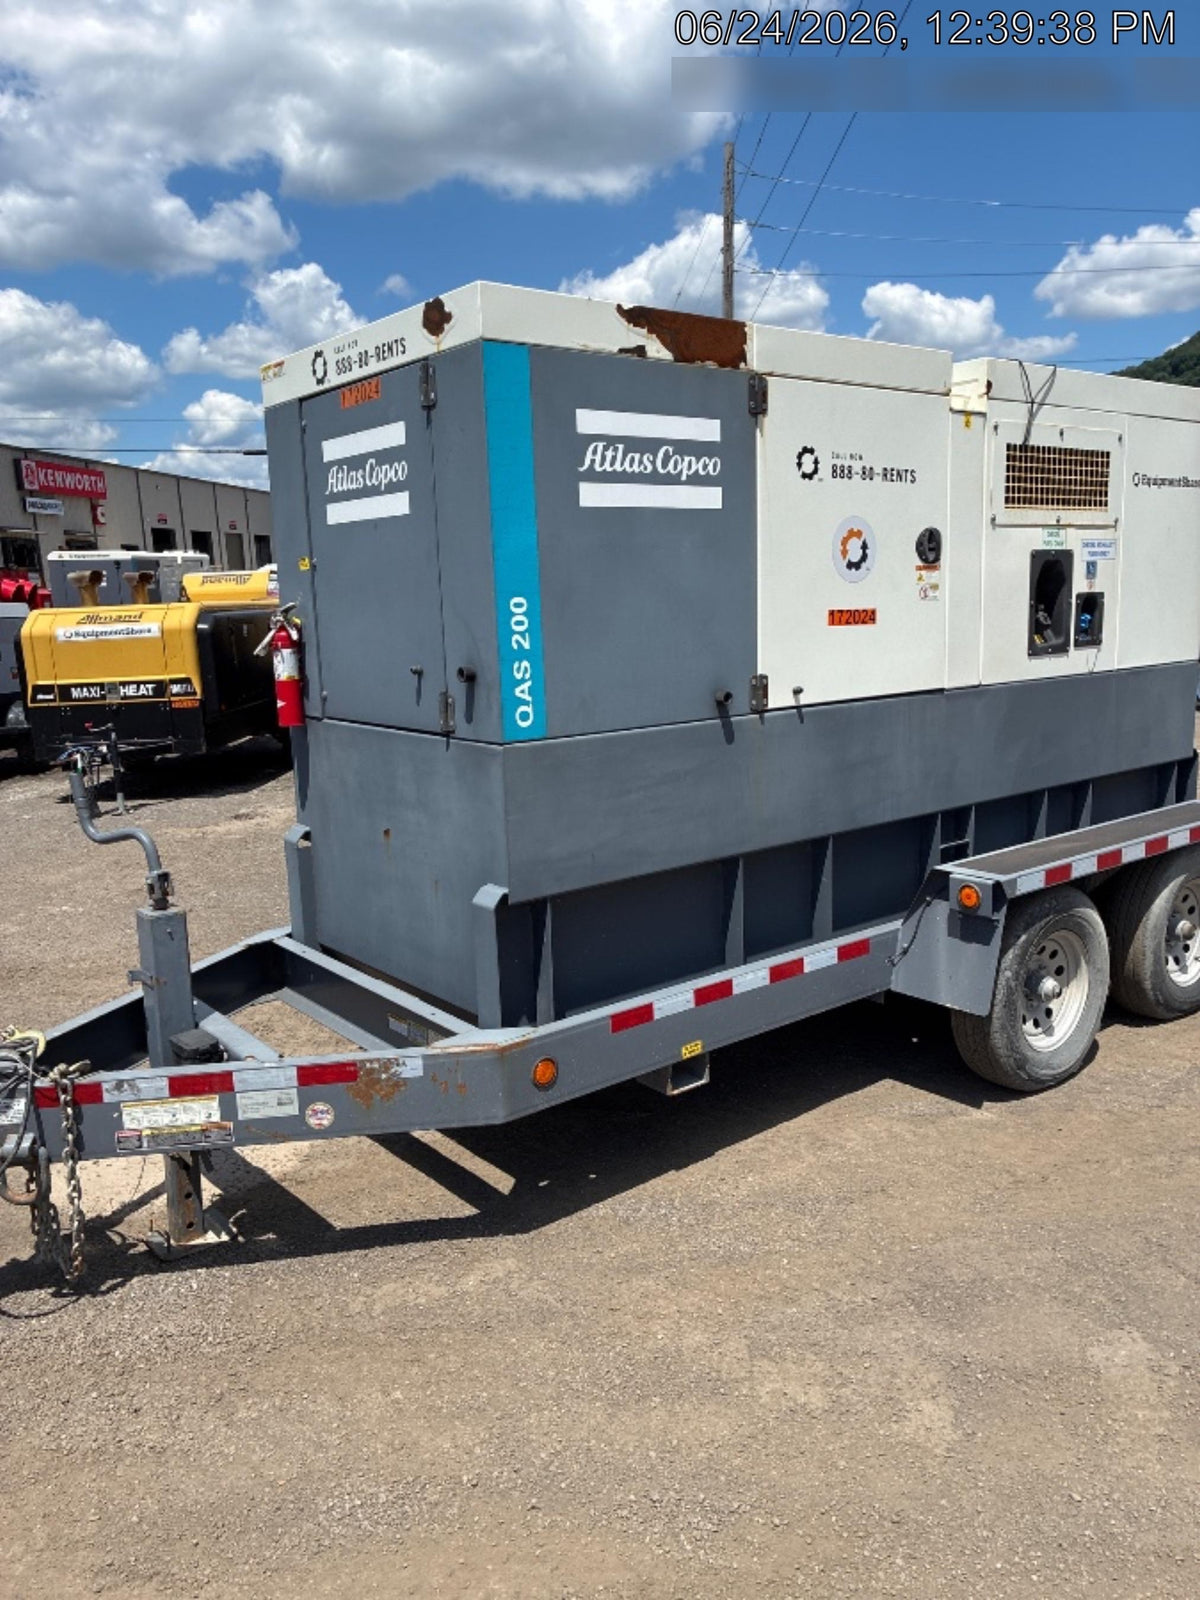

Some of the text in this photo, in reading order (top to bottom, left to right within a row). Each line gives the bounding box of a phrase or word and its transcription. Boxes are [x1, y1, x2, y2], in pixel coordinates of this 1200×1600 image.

[325, 458, 408, 495] Atlas Copco
[577, 441, 721, 481] Atlas Copco
[831, 463, 917, 484] 888-80-RENTS
[38, 467, 105, 493] KENWORTH
[827, 608, 877, 625] 172024
[509, 596, 534, 728] QAS 200
